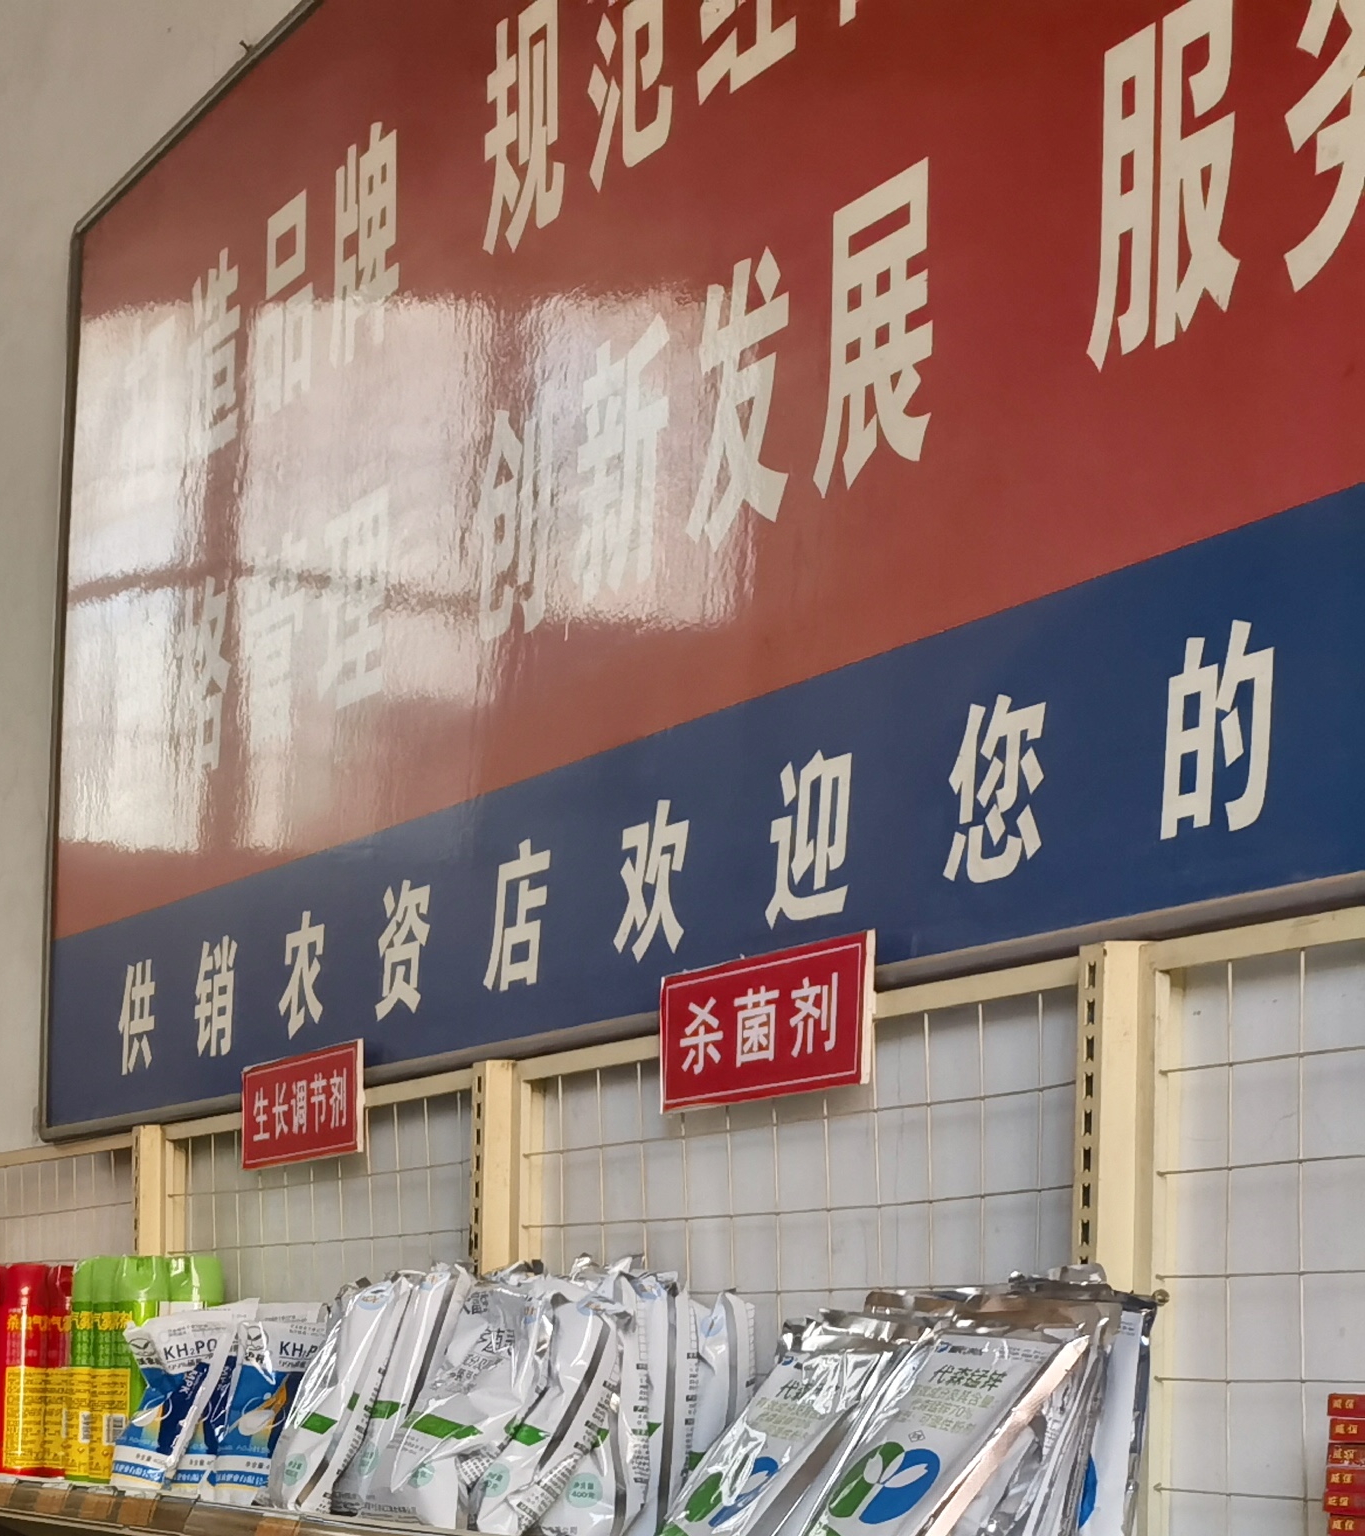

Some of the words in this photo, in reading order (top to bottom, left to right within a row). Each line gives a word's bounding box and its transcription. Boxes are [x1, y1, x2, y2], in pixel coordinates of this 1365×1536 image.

[119, 121, 401, 500] 造品牌
[481, 0, 857, 255] 规范
[472, 156, 934, 643] 创新发展
[118, 618, 1277, 1077] 供销农资店欢迎您的
[251, 1065, 349, 1141] 生长调节剂
[679, 974, 840, 1077] 杀菌剂
[928, 1363, 1008, 1392] 代森锰锌
